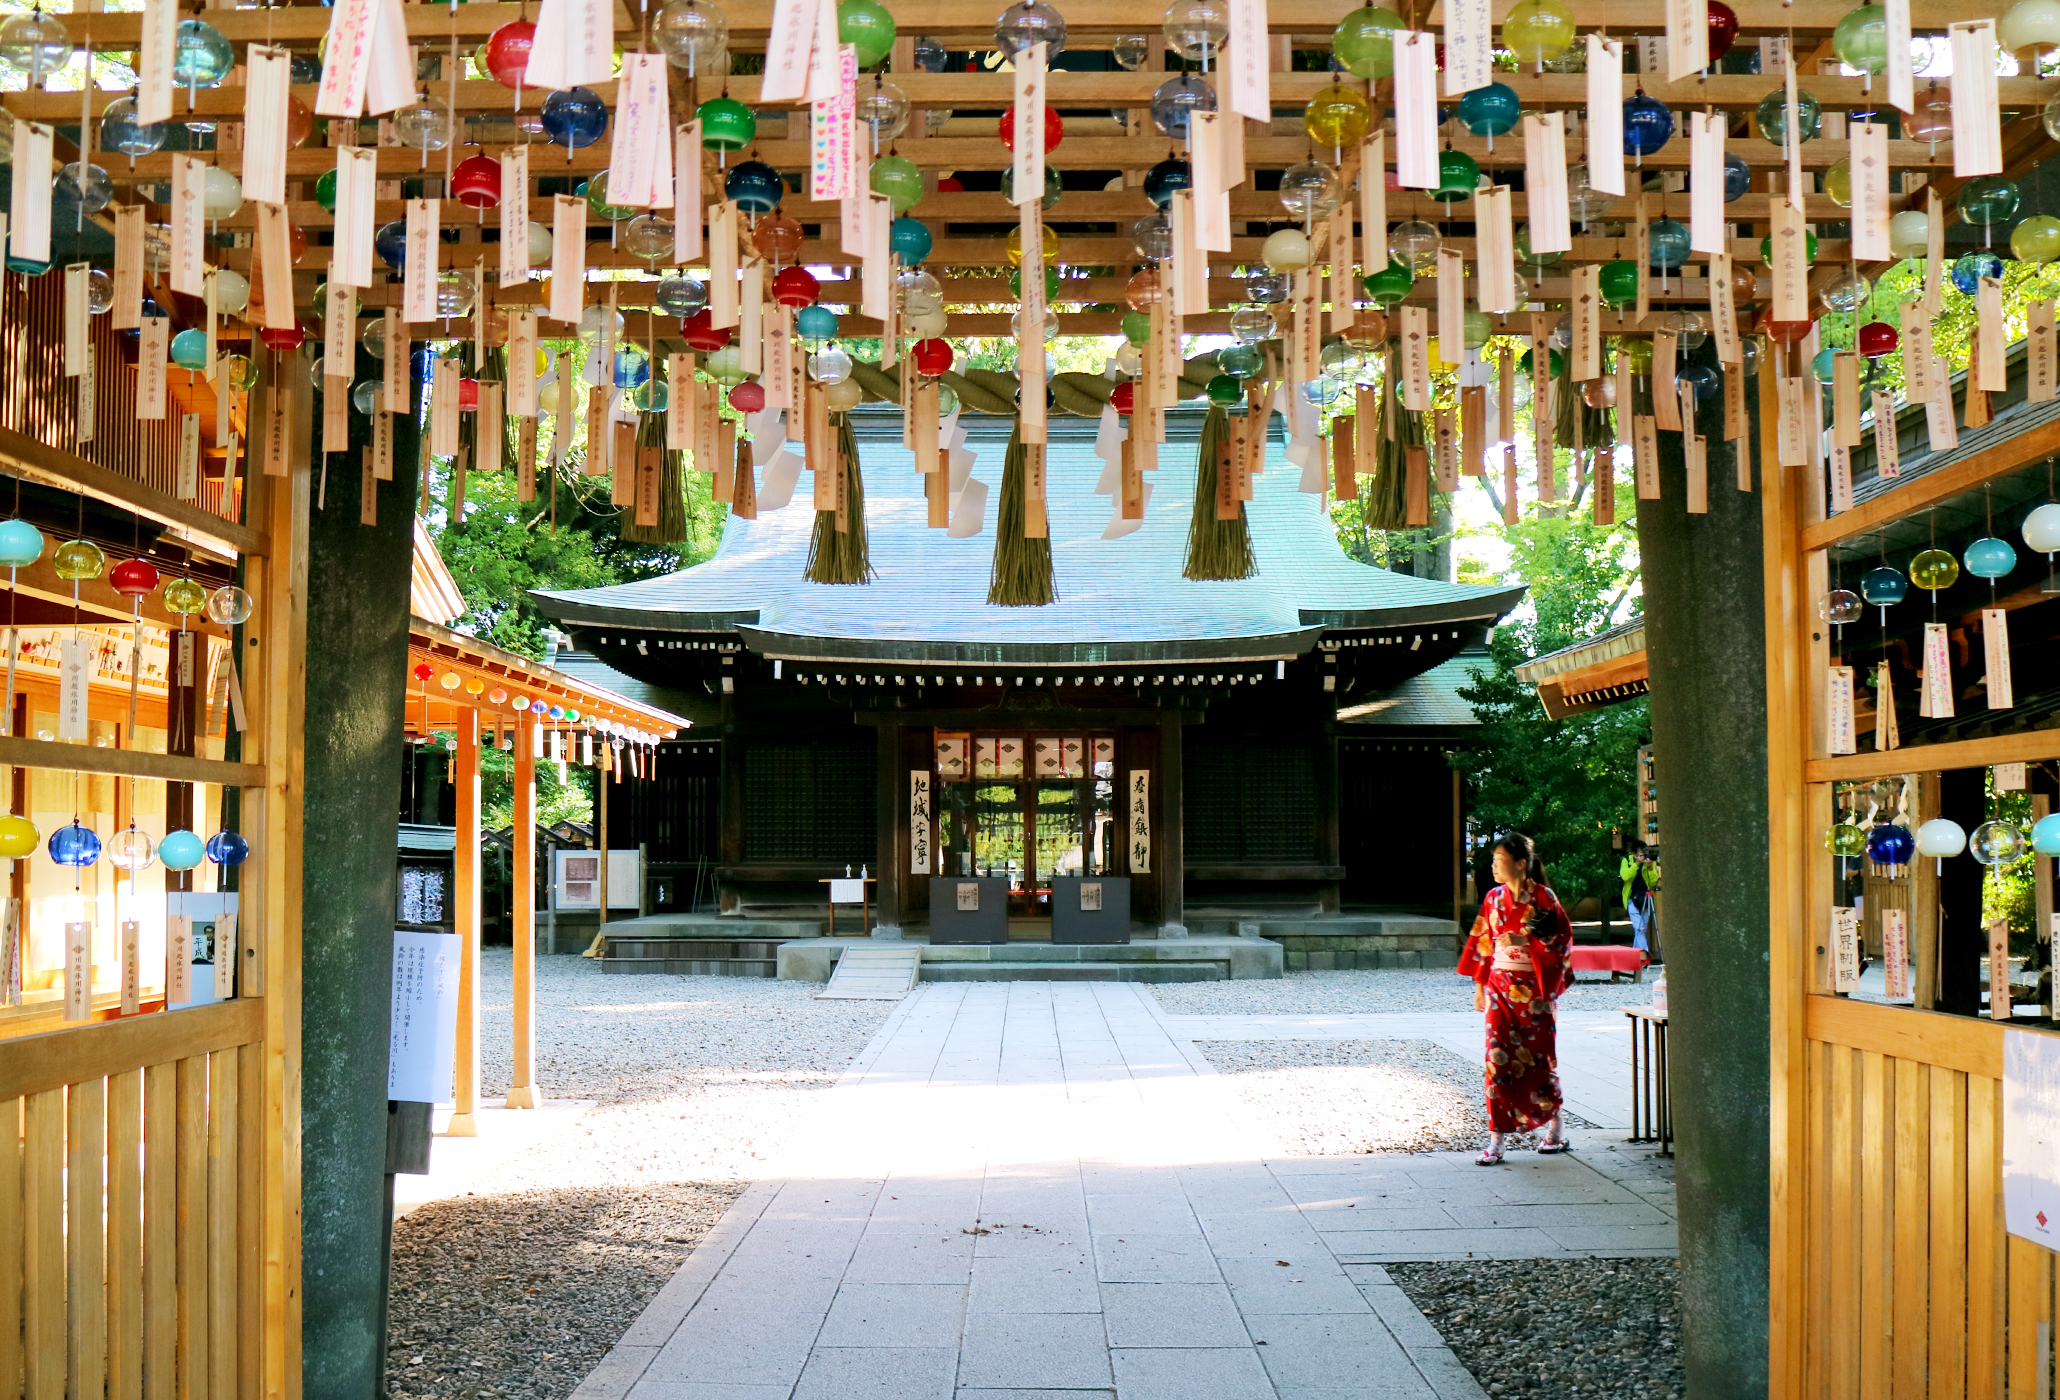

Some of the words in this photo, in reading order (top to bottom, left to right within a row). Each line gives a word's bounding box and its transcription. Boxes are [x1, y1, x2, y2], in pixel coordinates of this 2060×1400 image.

[1682, 0, 1694, 46] 川神社
[1025, 102, 1034, 174] 川越氷川神社
[1865, 174, 1875, 238] 川越氷川神社
[416, 242, 426, 301] 川越氷川神社
[336, 302, 344, 358] 川越氷川神社
[1581, 308, 1590, 362] 川越氷川神社
[1719, 291, 1731, 345] 川越氷川神社
[148, 351, 157, 403] 川越氷川神社
[393, 343, 401, 395] 川越氷川神社
[774, 341, 782, 392] 川越氷川神社
[1411, 342, 1420, 394] 川越氷川神社
[1912, 339, 1924, 387] 川越氷川神社
[2038, 339, 2046, 386] 川越氷川神社
[1642, 446, 1652, 486] 川越氷川神社
[1836, 458, 1845, 498] 川越氷川神社
[70, 673, 78, 723] 川越氷川神社
[912, 776, 930, 865] 地域安寧
[175, 945, 183, 989] 川越氷川神社
[193, 938, 204, 959] 平成
[1839, 918, 1855, 982] 世界制服
[74, 956, 82, 1005] 川越氷川神社
